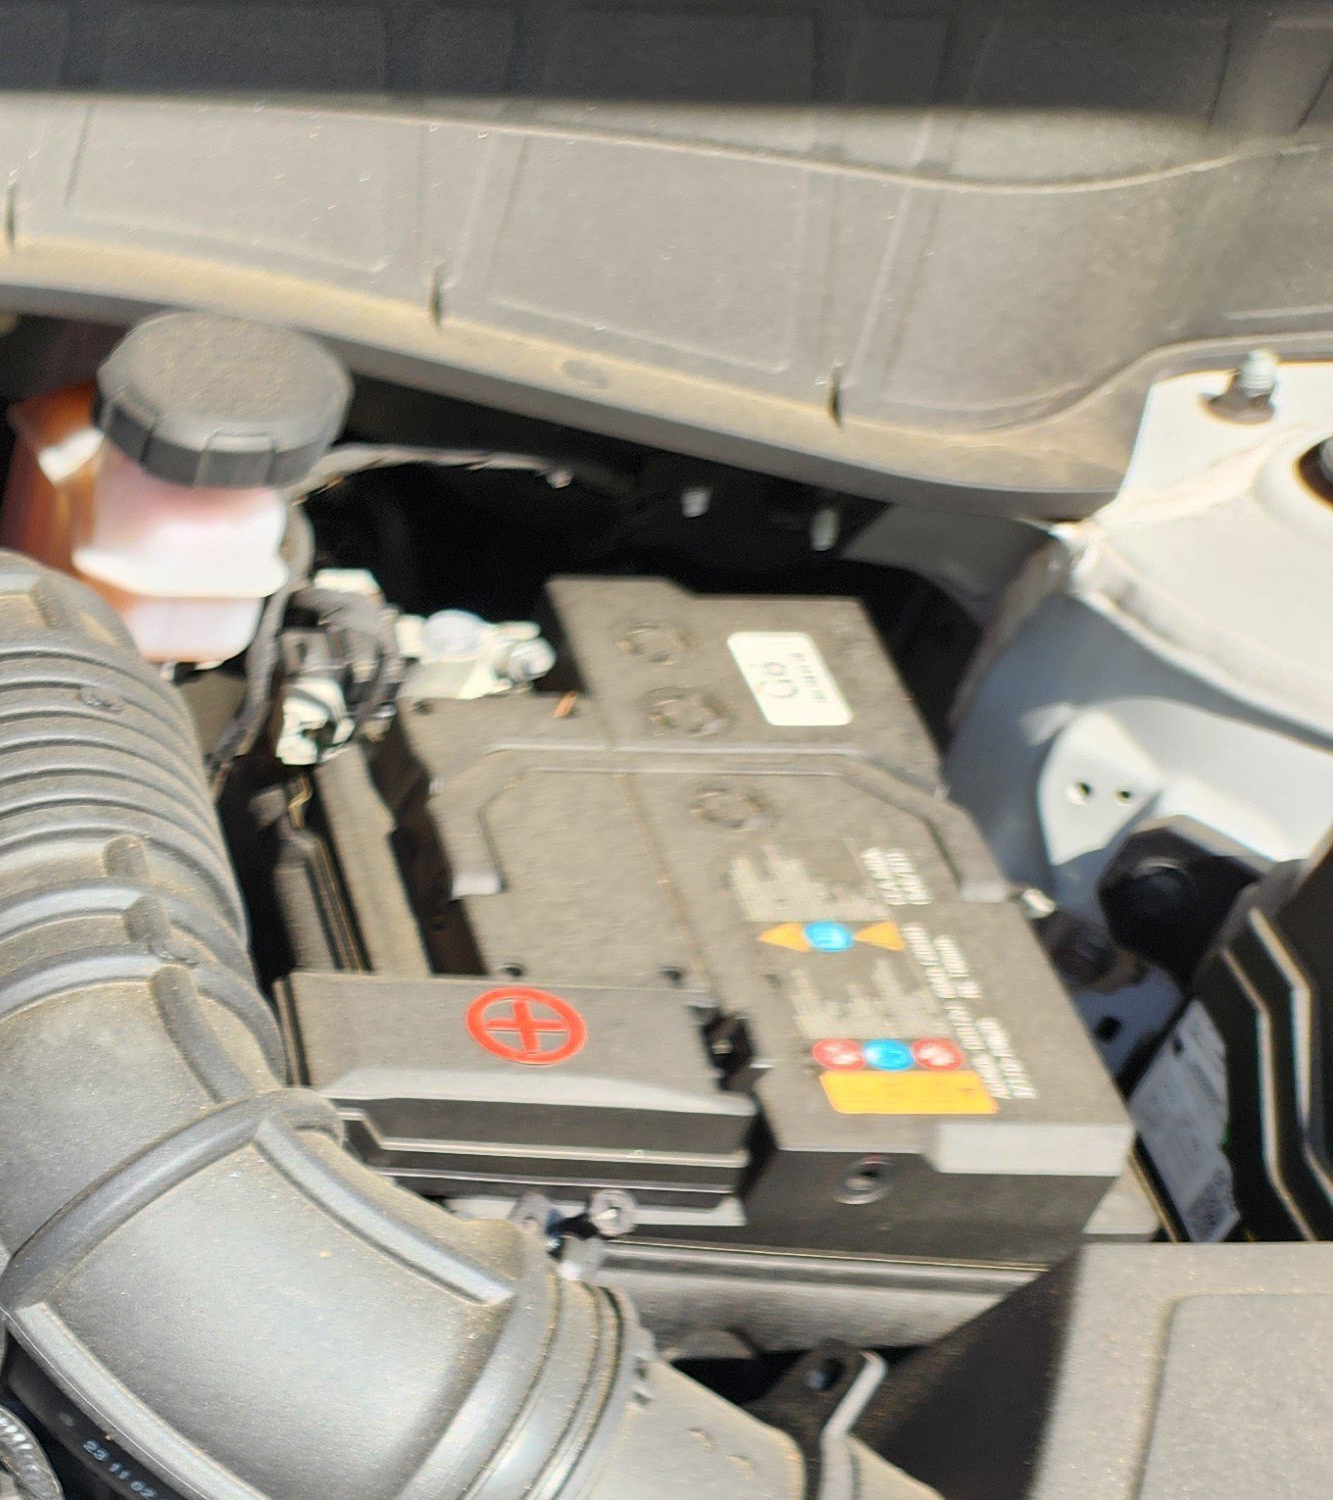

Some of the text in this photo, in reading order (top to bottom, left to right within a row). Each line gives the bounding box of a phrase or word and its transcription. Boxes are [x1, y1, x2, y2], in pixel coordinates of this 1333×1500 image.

[83, 1439, 109, 1461] 23
[109, 1462, 130, 1479] 11
[130, 1480, 157, 1499] 02
